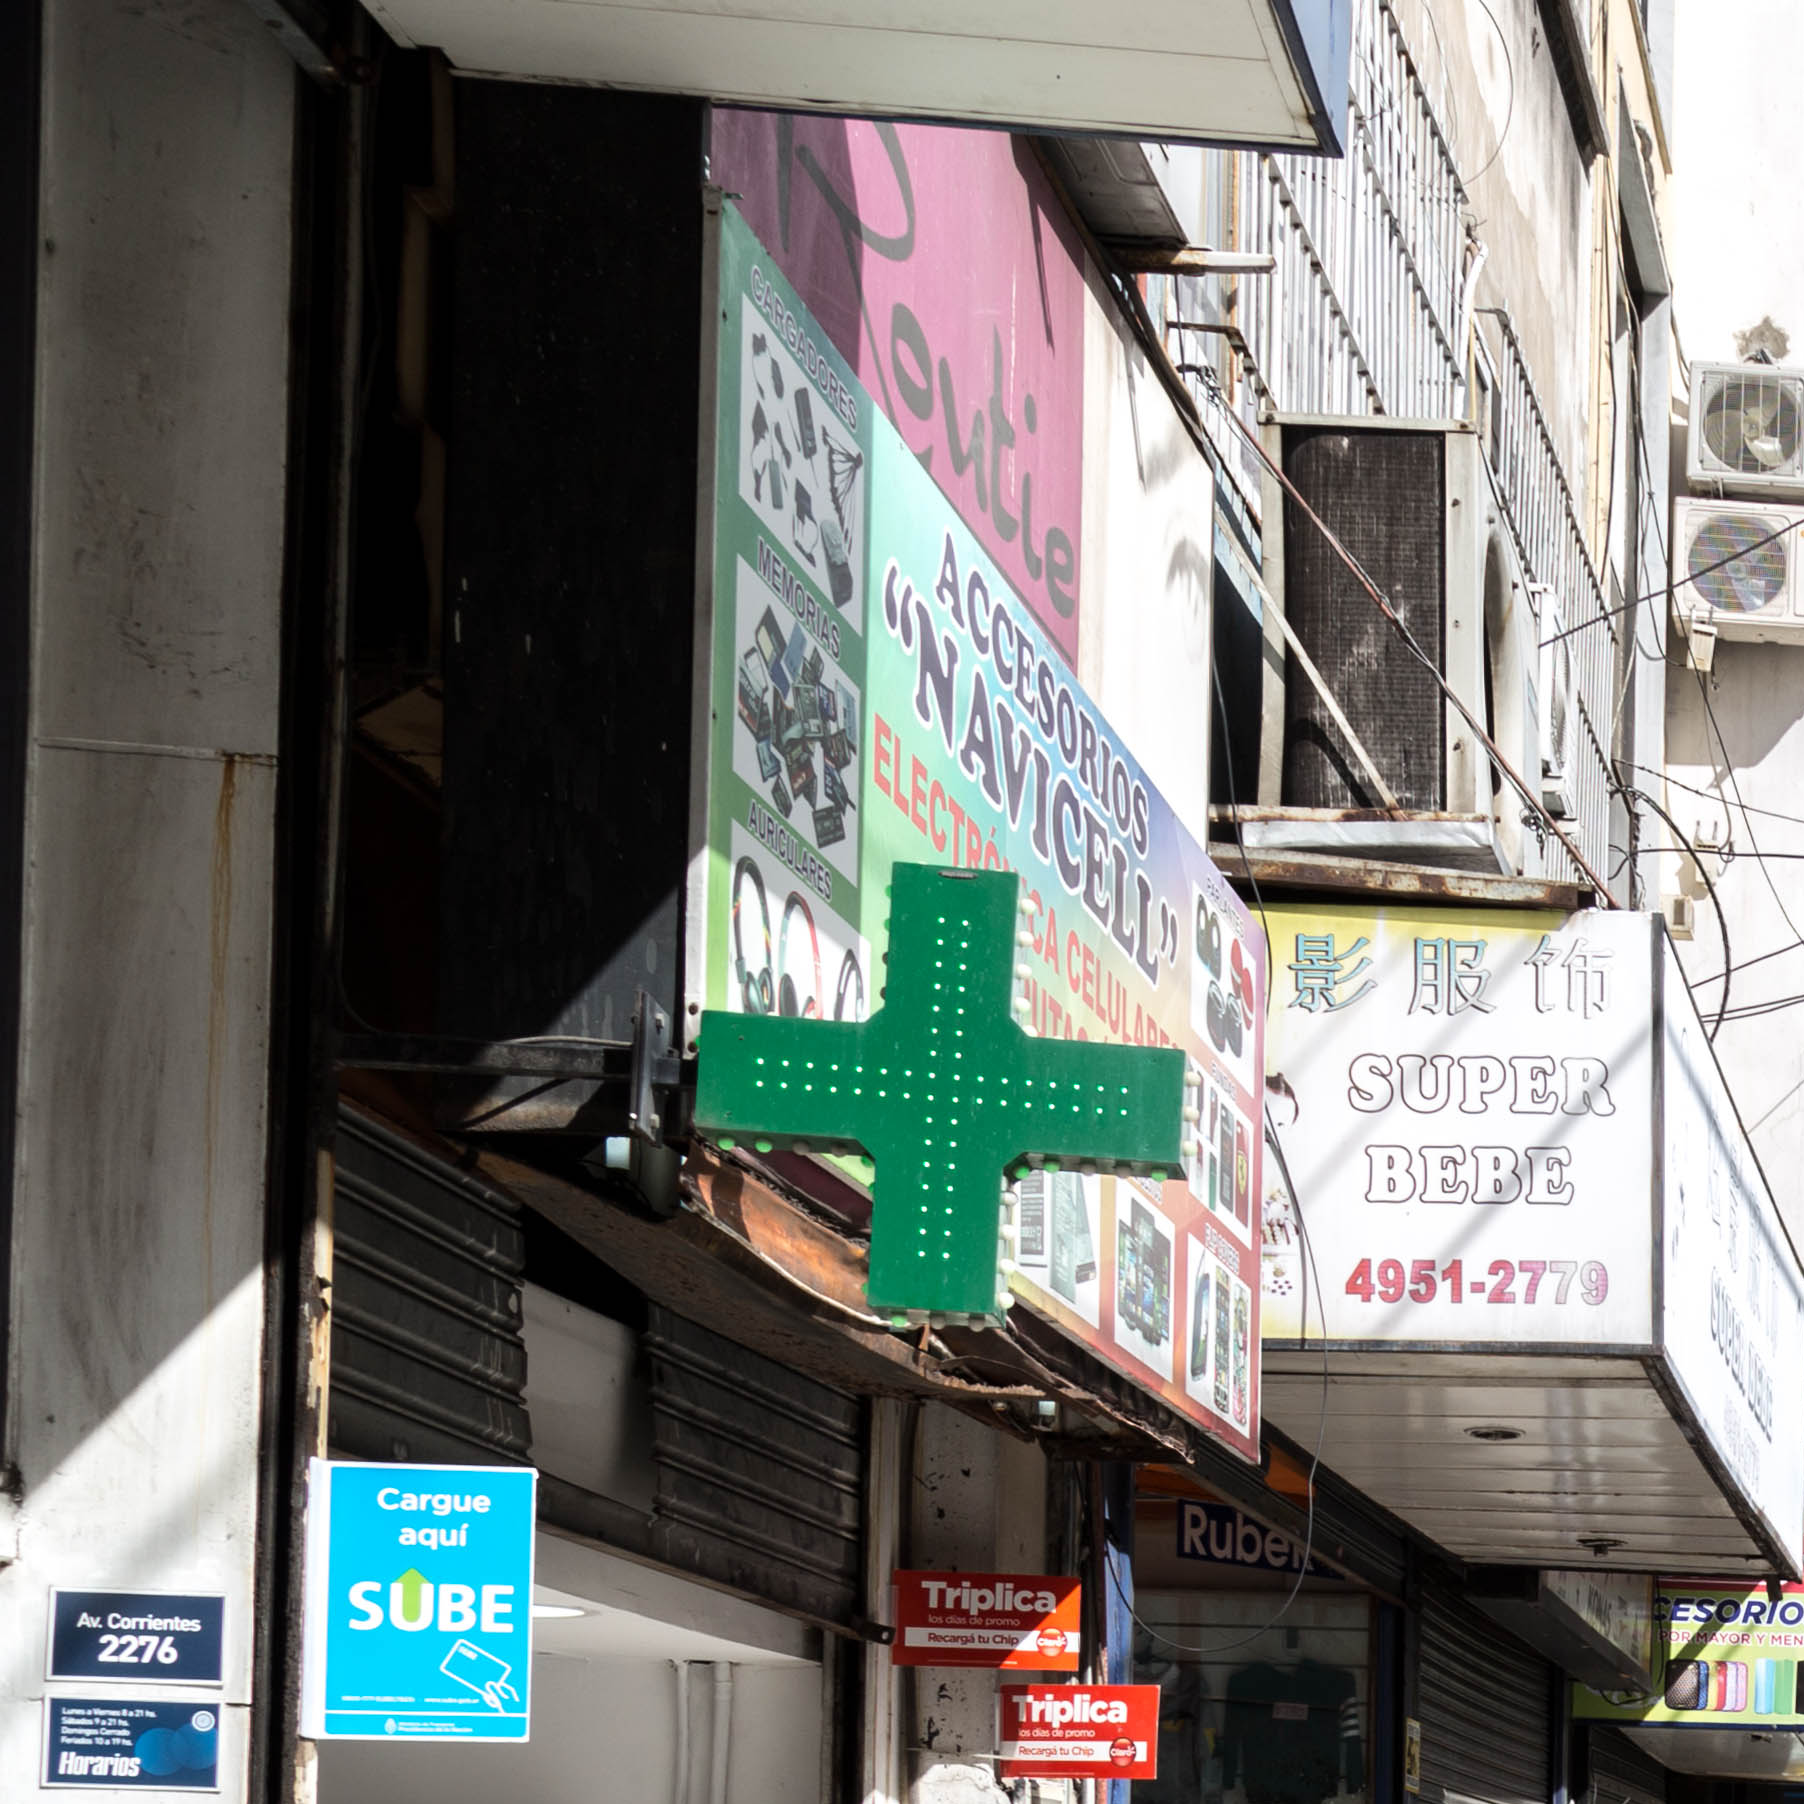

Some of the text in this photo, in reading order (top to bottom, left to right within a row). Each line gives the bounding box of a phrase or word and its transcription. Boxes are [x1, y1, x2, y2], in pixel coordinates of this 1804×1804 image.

[751, 264, 860, 432] CARGADORES
[757, 536, 841, 660] MEMORIAS
[936, 533, 1150, 861] ACCESORIOS
[747, 798, 832, 902] AURICULARES
[1347, 1053, 1617, 1118] SUPER
[1365, 1144, 1576, 1205] BEBE
[1345, 1259, 1609, 1306] 4951-2779
[376, 1487, 492, 1516] Cargue
[398, 1522, 470, 1549] aquí
[348, 1580, 516, 1634] SUBE
[921, 1580, 1057, 1616] Triplica
[76, 1612, 203, 1632] Av. Corrientes
[970, 1616, 983, 1626] de
[985, 1617, 1021, 1628] promo
[1658, 1630, 1691, 1643] POR
[1695, 1630, 1752, 1646] MAYOR
[1754, 1632, 1766, 1645] Y
[97, 1633, 179, 1664] 2276
[977, 1634, 991, 1644] tu
[992, 1633, 1020, 1647] Chip
[1011, 1693, 1128, 1728] Triplica
[1018, 1728, 1096, 1739] los de promo
[58, 1750, 141, 1777] Horarios
[1059, 1747, 1070, 1756] tu
[1071, 1746, 1095, 1758] Chip
